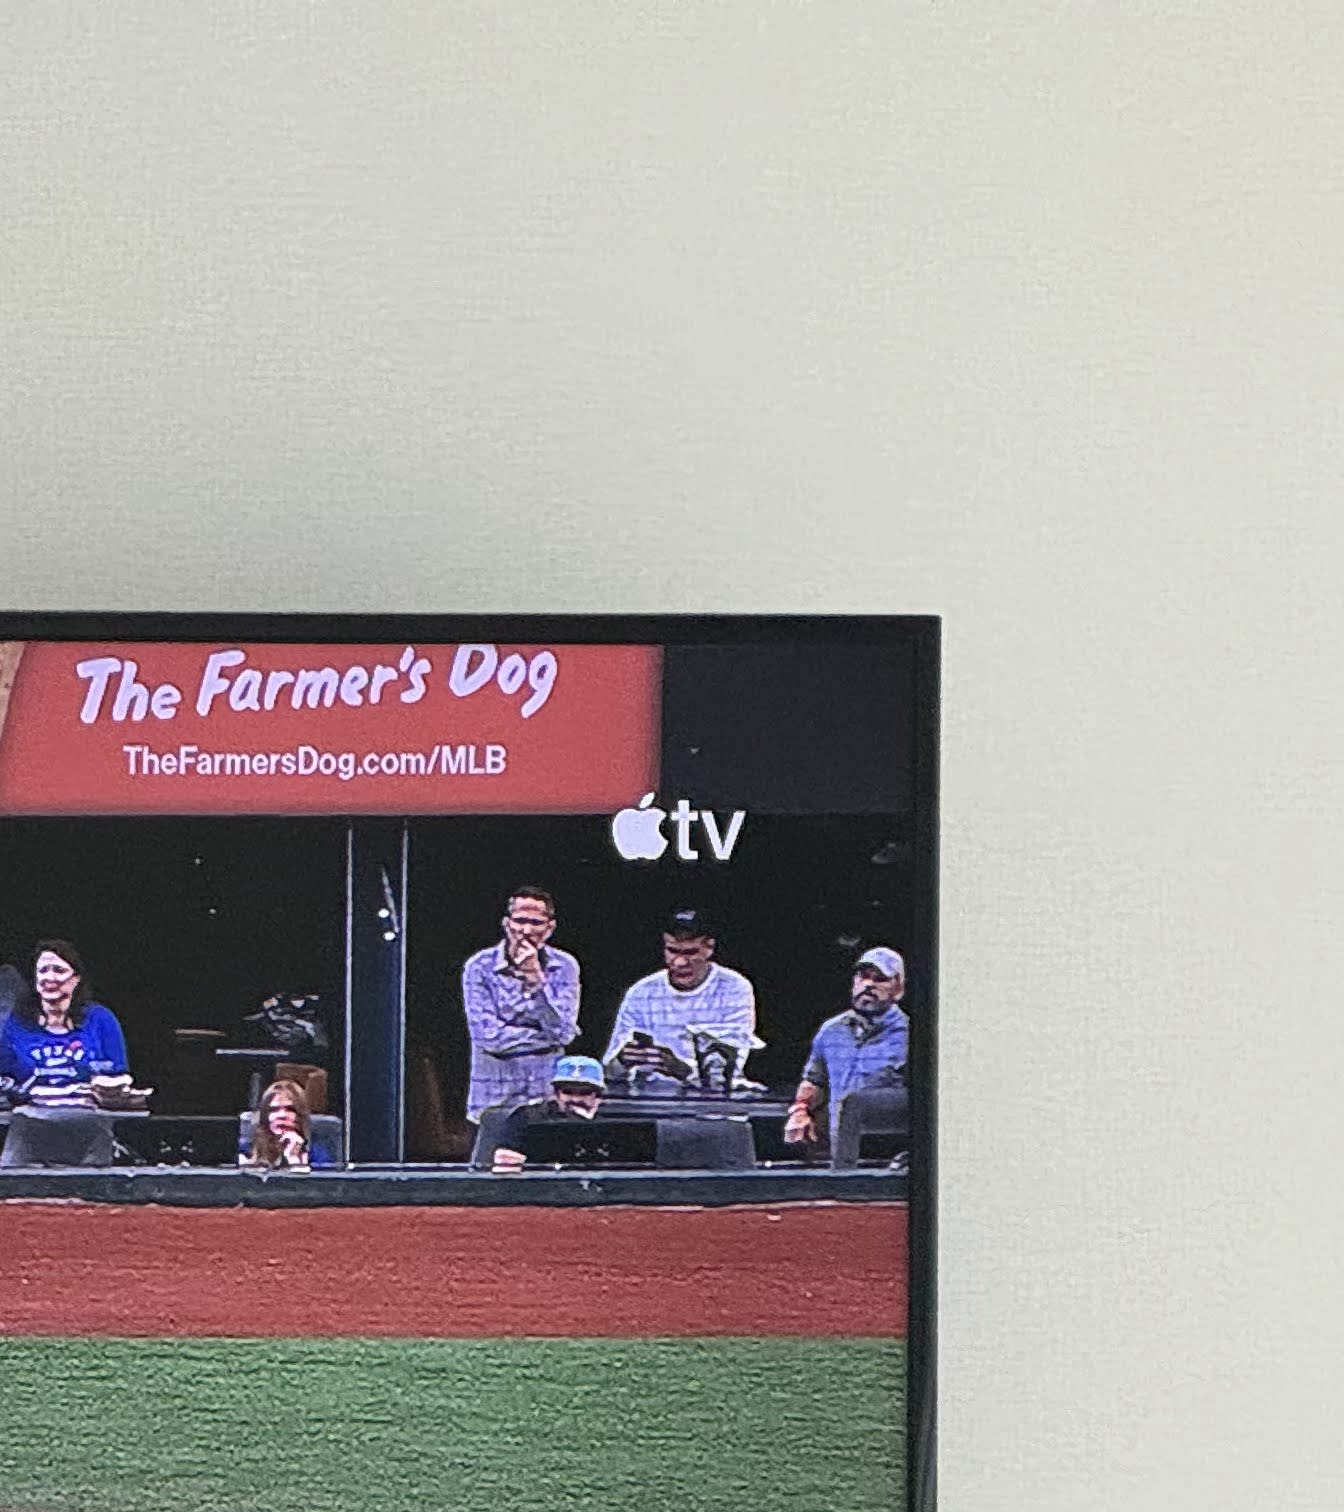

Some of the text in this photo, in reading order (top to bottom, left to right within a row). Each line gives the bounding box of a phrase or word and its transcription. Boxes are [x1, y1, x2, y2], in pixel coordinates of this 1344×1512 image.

[76, 644, 559, 724] The Farmer's Dog
[122, 744, 507, 780] TheFarmersDog.com/MLB
[671, 799, 746, 861] tv
